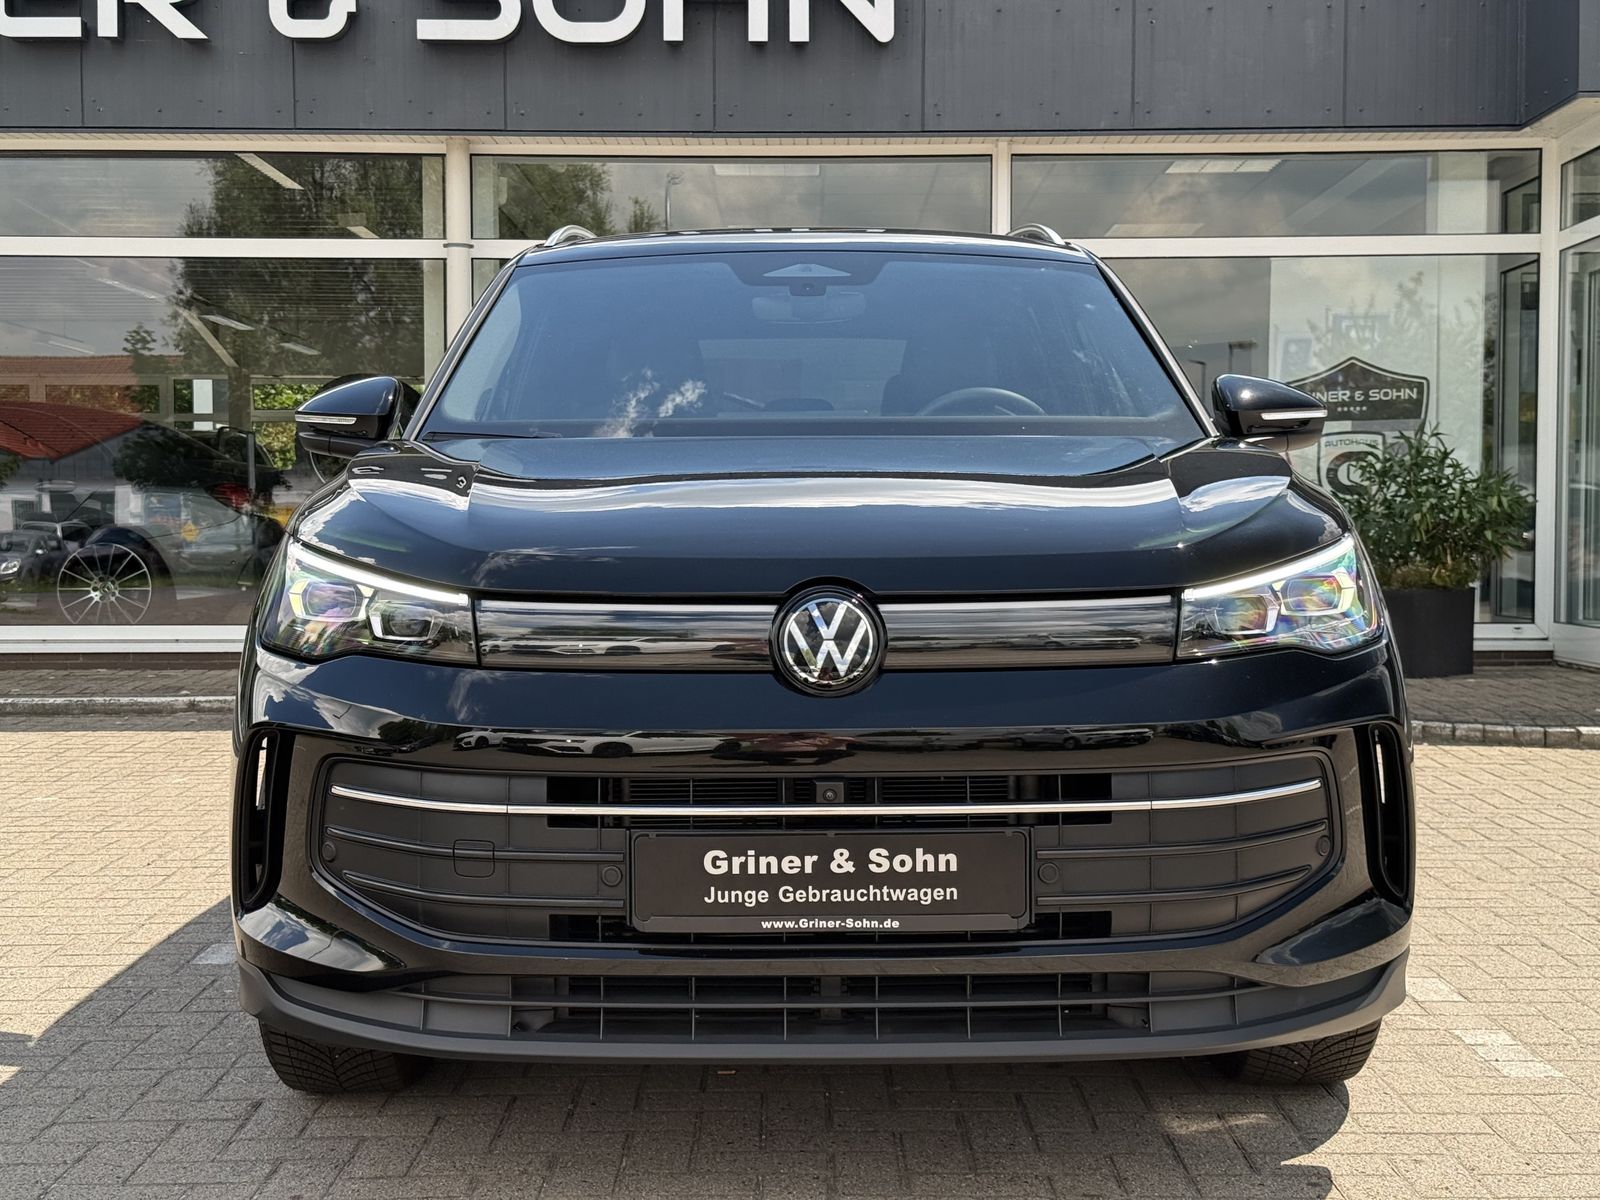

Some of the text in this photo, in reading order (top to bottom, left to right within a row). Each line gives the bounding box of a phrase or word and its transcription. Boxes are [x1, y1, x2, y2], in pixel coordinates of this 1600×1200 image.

[1354, 390, 1365, 401] &
[1368, 388, 1418, 401] SOHN
[703, 847, 958, 875] Griner & Sohn
[703, 885, 958, 908] Junge Gebrauchtwagen
[760, 918, 900, 929] www.Griner-Sohn.de
